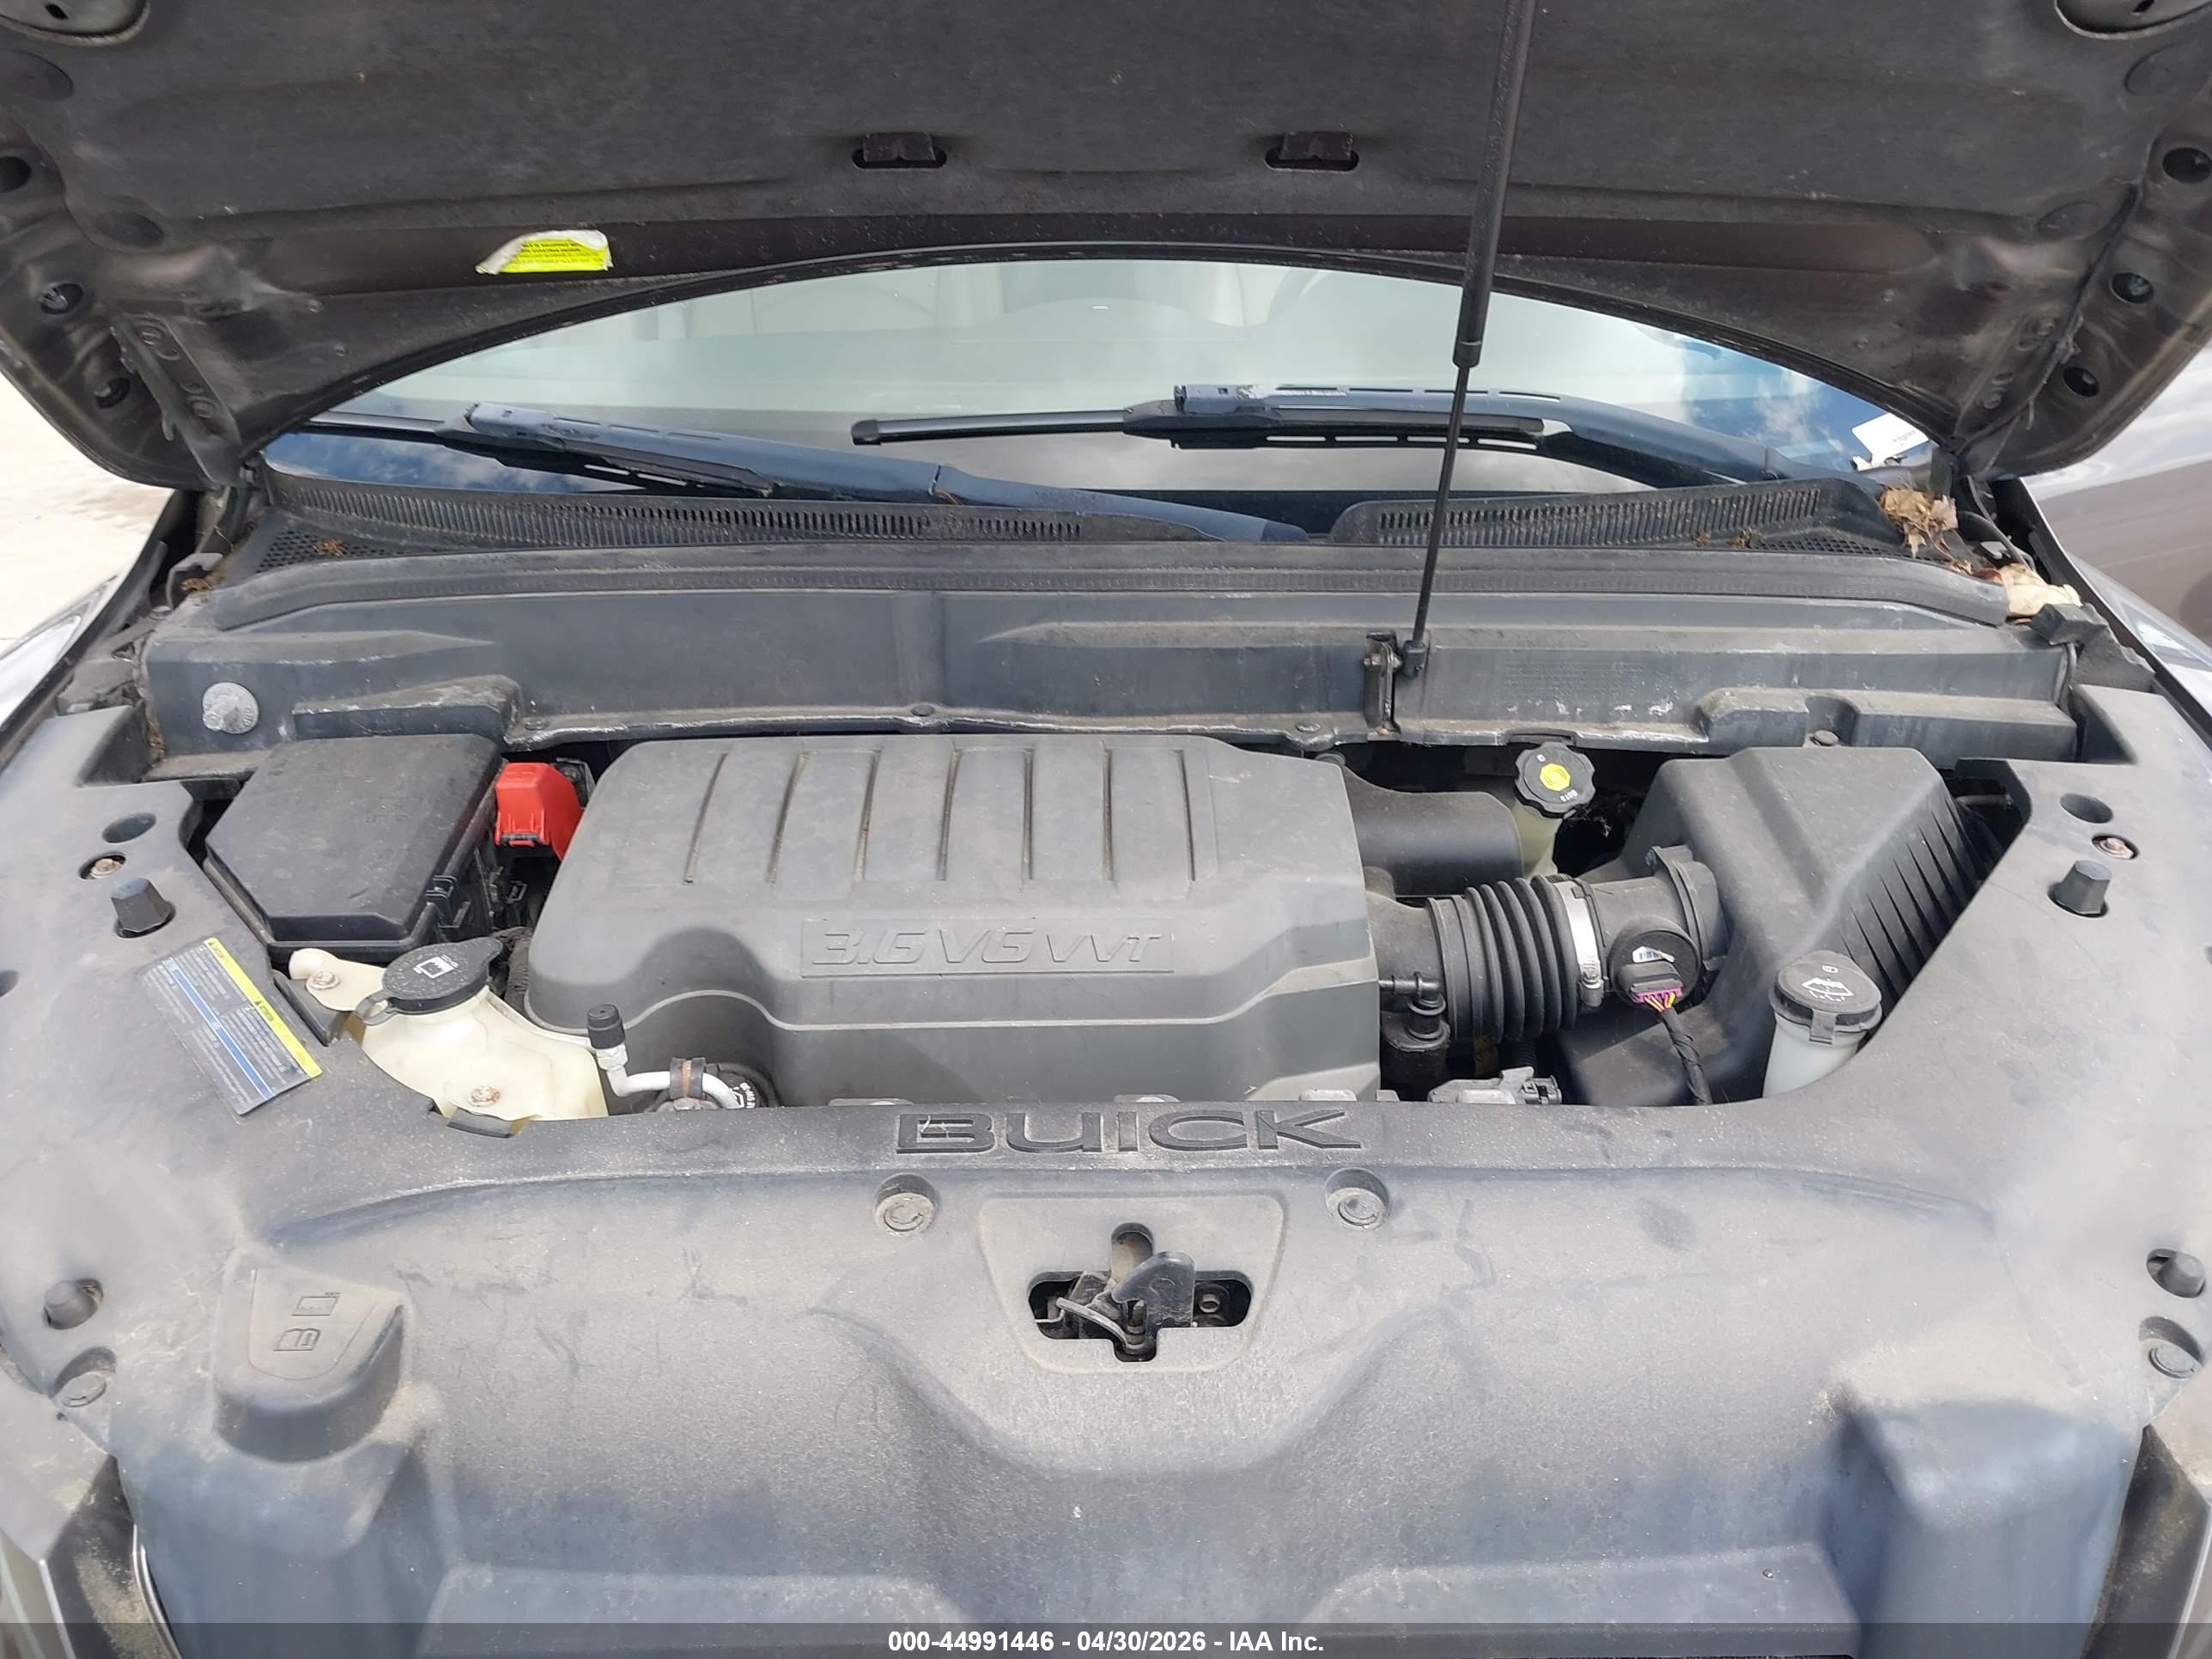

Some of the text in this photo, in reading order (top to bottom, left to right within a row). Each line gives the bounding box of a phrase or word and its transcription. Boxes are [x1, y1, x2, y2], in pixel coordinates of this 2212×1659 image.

[811, 927, 1163, 965] 3.6 V6 VVT
[896, 1108, 1361, 1154] BUICK
